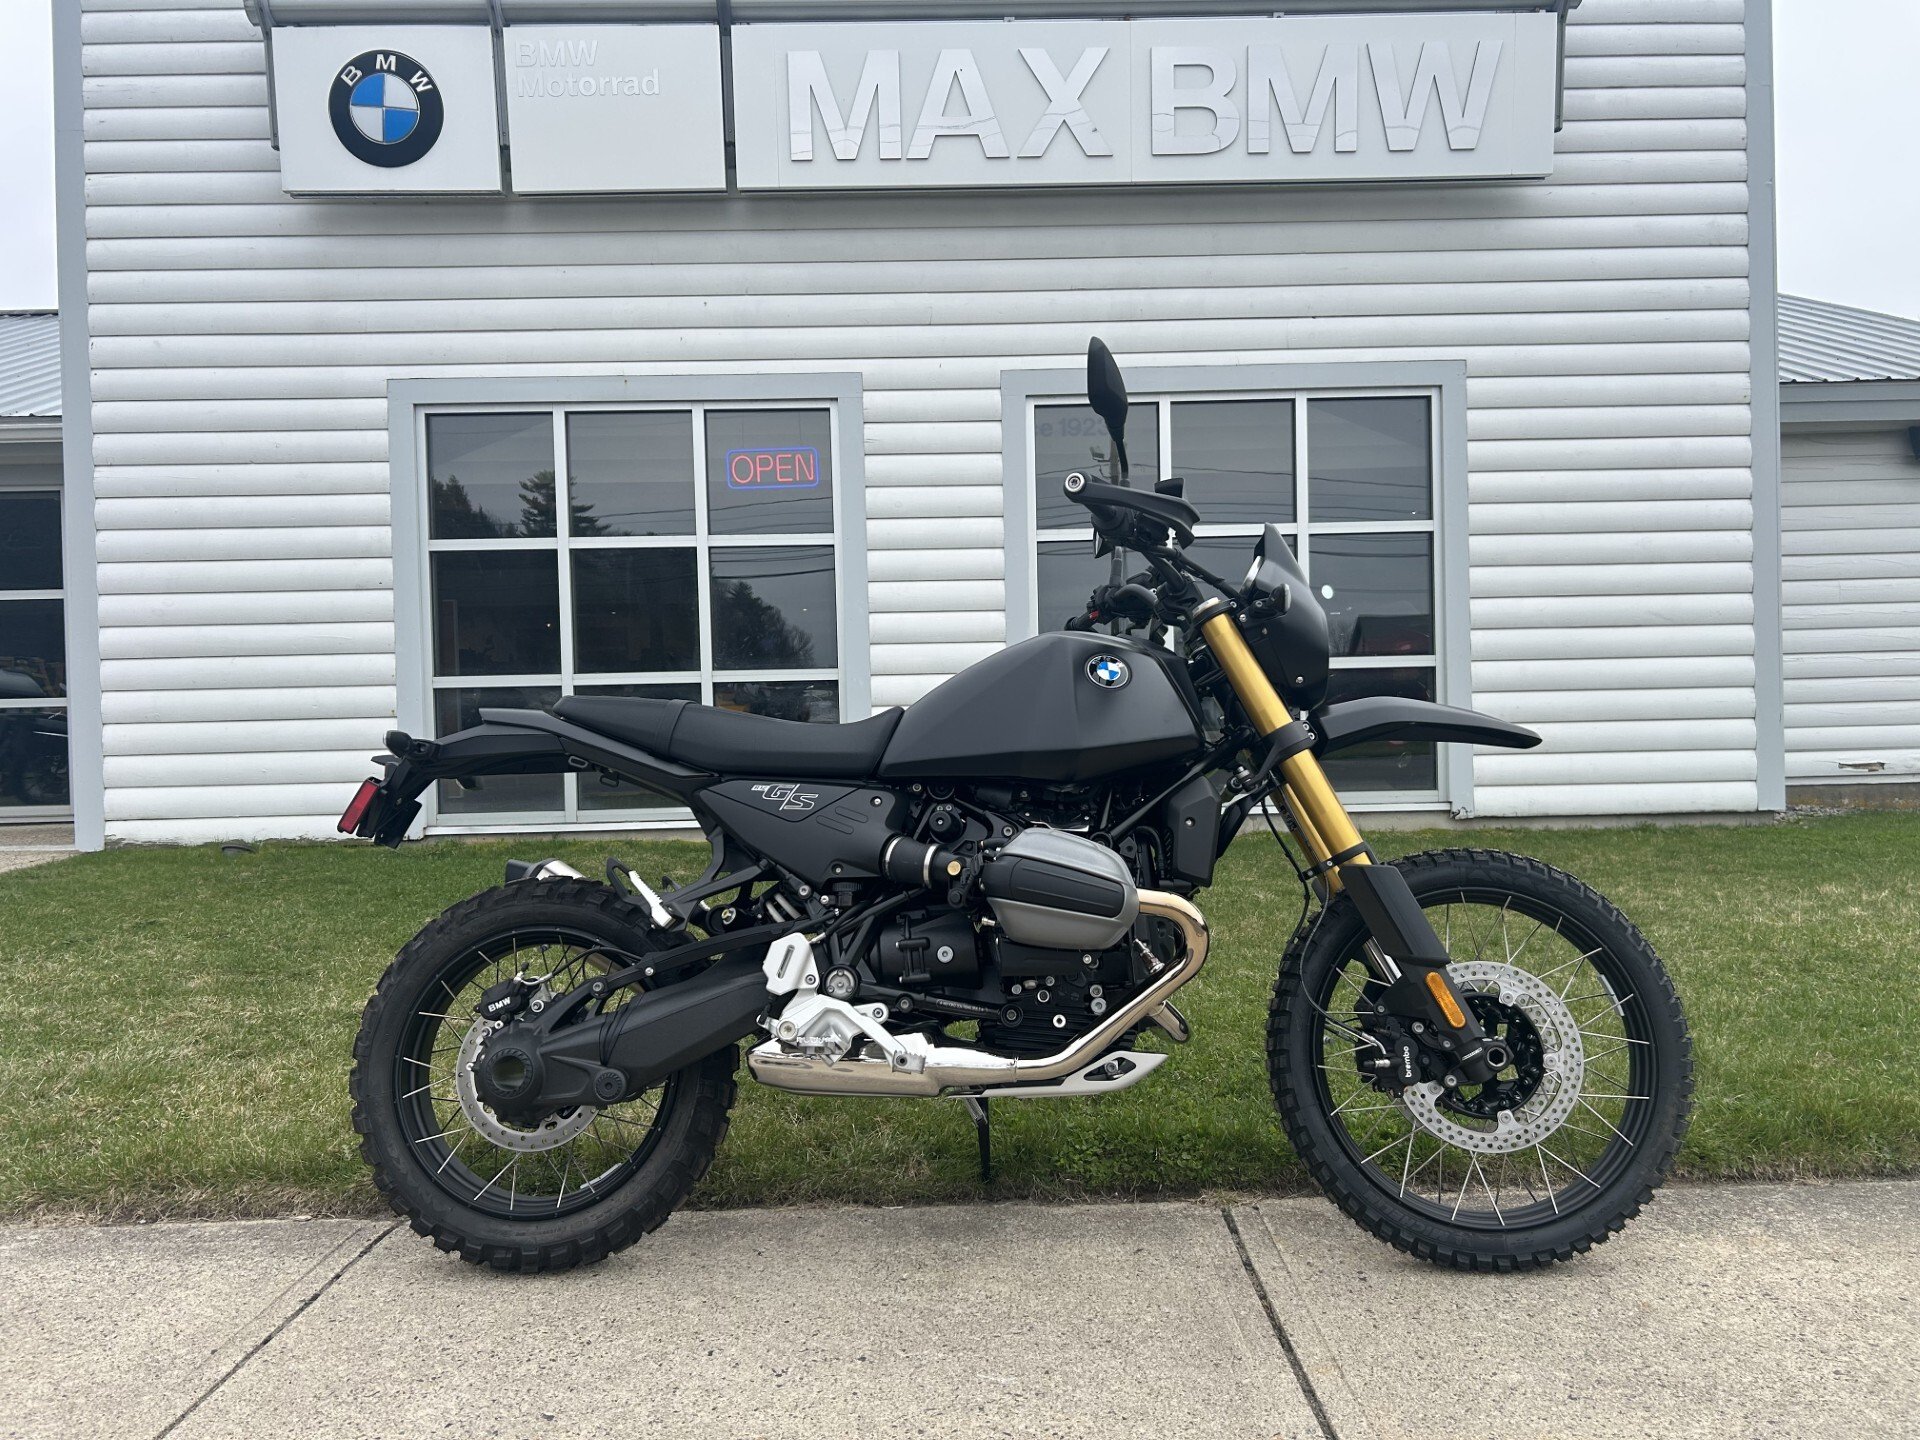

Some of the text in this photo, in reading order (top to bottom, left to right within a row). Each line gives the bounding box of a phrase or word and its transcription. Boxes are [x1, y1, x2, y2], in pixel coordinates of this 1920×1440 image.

[515, 39, 598, 68] BMW
[340, 53, 434, 93] BMW
[517, 67, 661, 98] Motorrad
[786, 40, 1504, 161] MAX BMW
[731, 453, 815, 484] OPEN
[487, 996, 511, 1013] BMW
[1402, 1045, 1413, 1078] brembo
